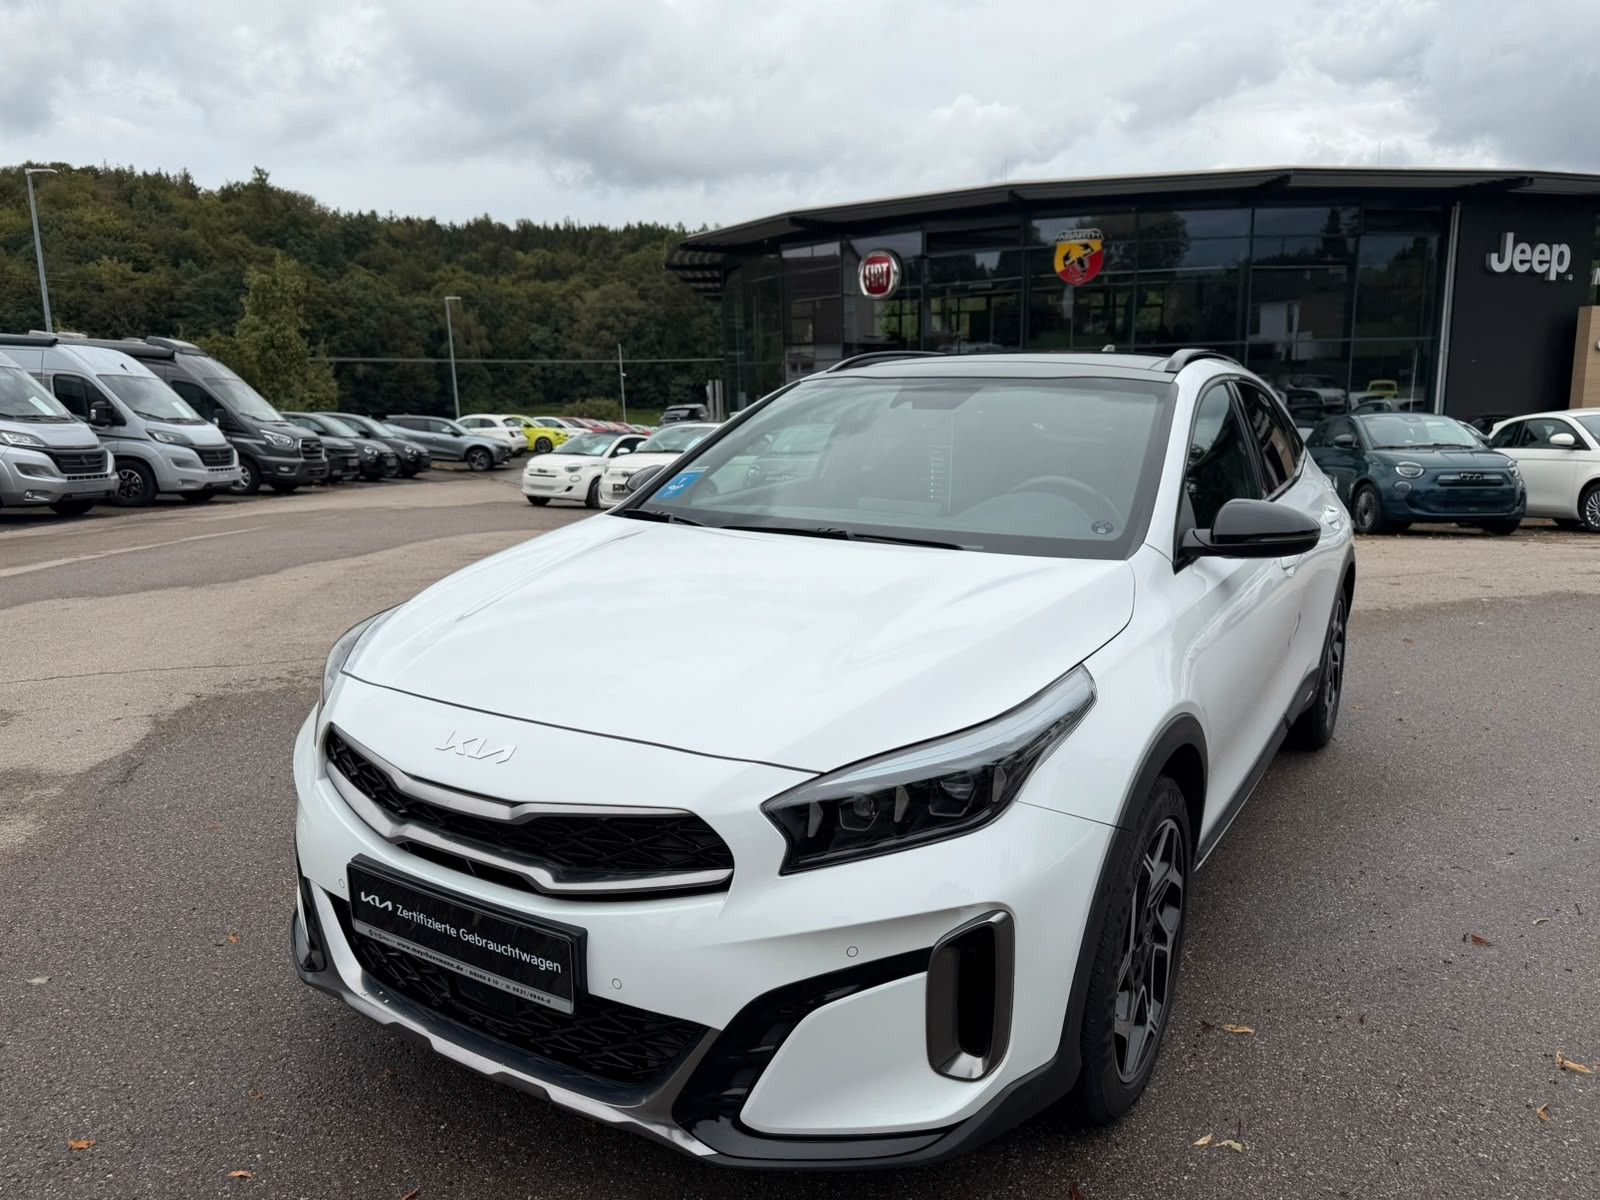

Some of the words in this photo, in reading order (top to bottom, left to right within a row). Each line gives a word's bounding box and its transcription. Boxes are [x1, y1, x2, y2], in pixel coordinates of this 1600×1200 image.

[864, 262, 889, 288] FIAT
[1487, 231, 1570, 281] Jeep
[396, 904, 457, 938] Zertifizierte
[459, 928, 562, 974] Gebrauchtwagen
